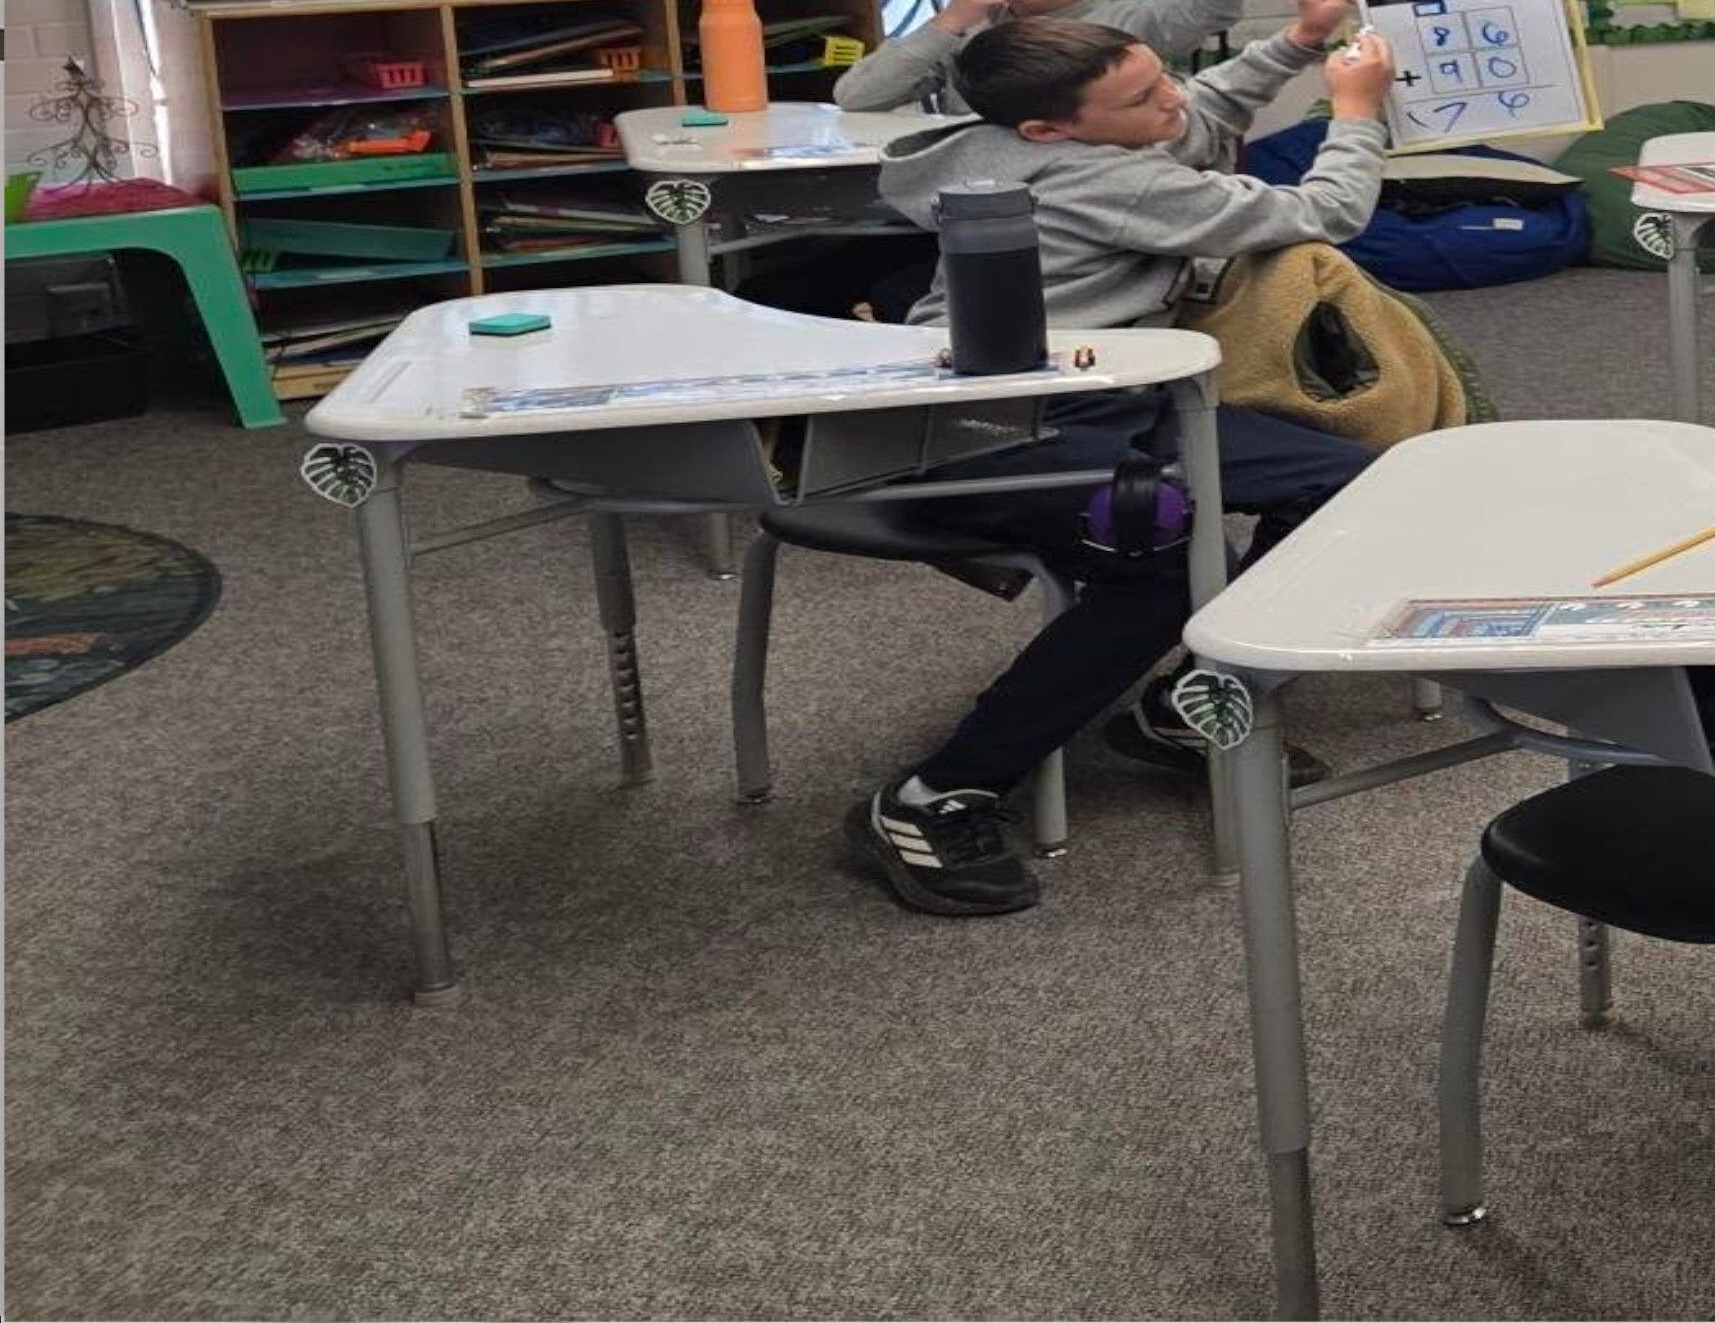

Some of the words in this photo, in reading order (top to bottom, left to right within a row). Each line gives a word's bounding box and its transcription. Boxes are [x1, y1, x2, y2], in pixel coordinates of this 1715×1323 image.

[1433, 26, 1450, 46] 8
[1482, 21, 1510, 45] 6
[1439, 59, 1463, 84] 9
[1487, 57, 1517, 79] 0
[1498, 91, 1530, 120] 6
